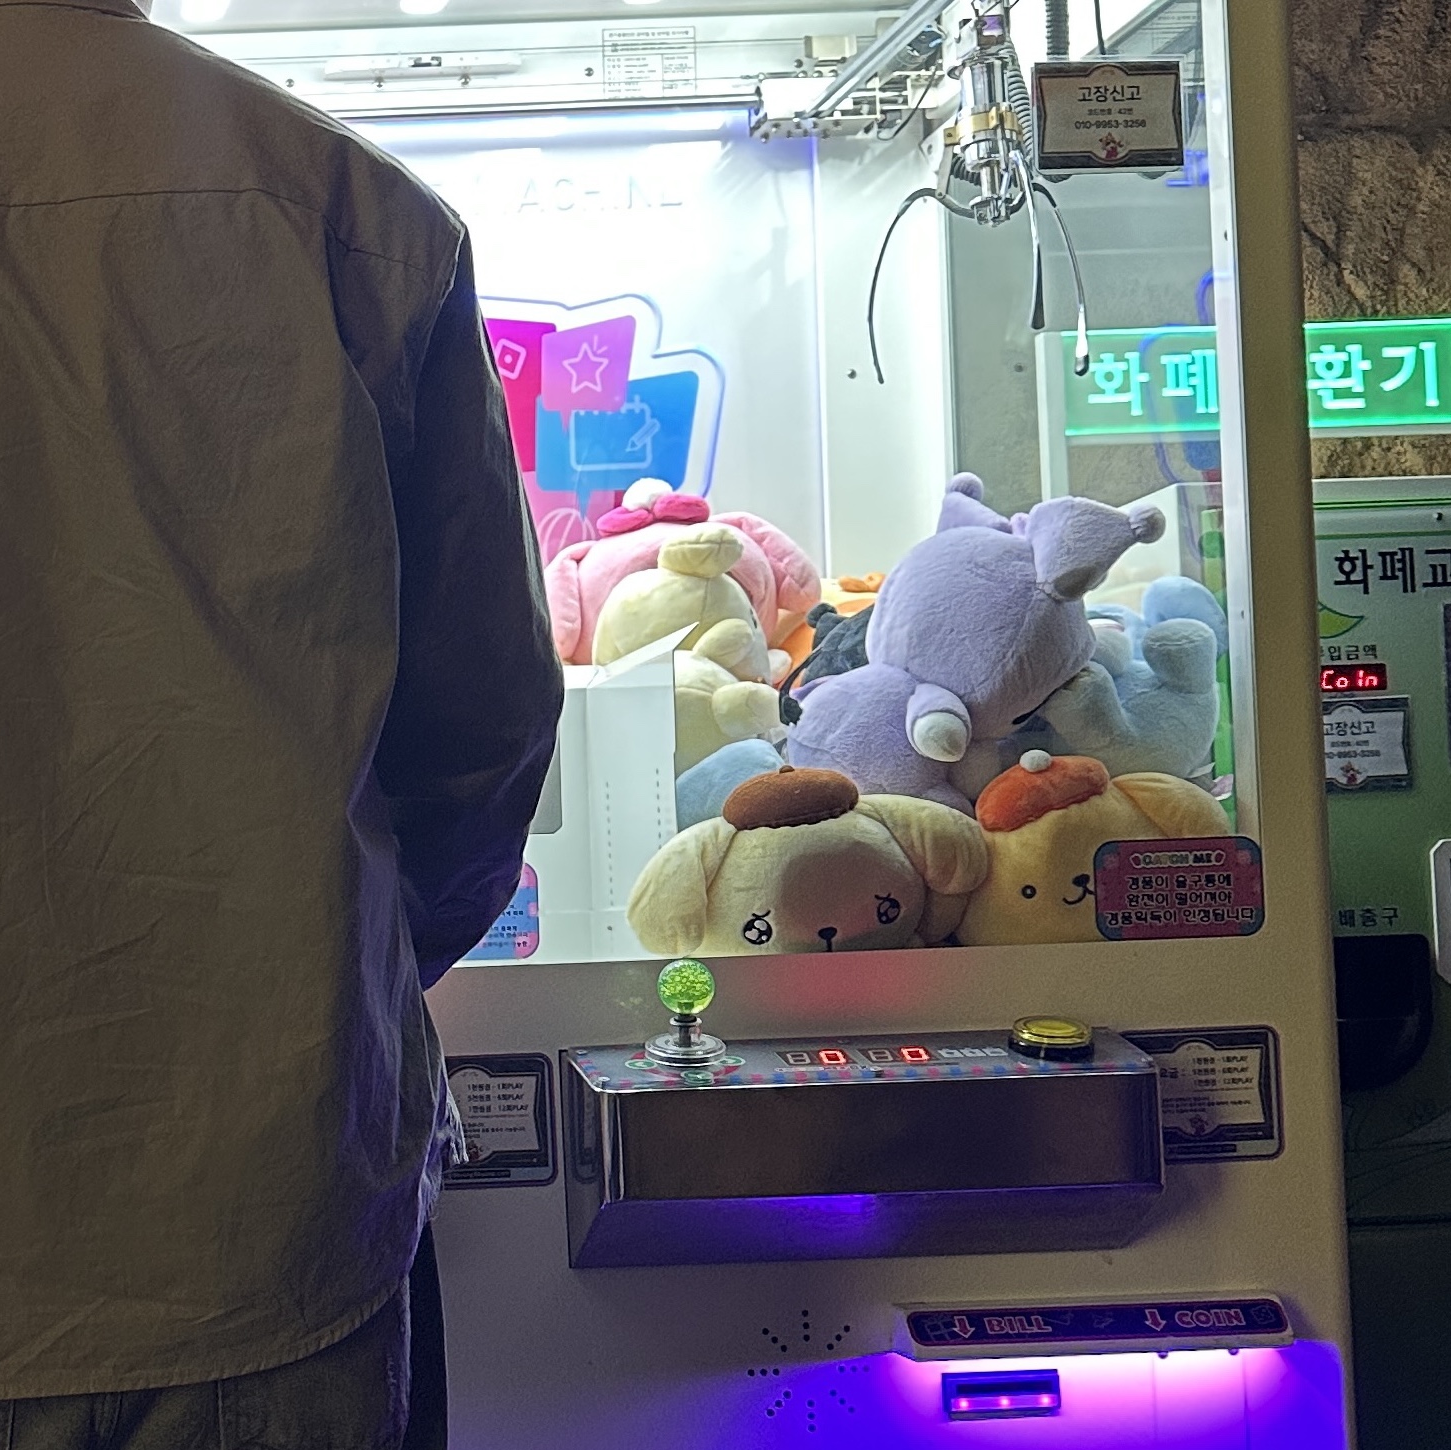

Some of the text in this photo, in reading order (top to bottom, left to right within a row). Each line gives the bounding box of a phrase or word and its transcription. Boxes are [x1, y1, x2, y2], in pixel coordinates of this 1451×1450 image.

[1078, 85, 1142, 102] 고장신고
[1320, 644, 1378, 661] 입금액
[1323, 721, 1376, 736] 고장신고
[1127, 874, 1232, 890] 경품이 출구통에
[1175, 891, 1232, 906] 떨어져야
[1106, 907, 1254, 926] 경품획득이 인정됩니다
[1339, 907, 1398, 928] 배출구
[1160, 1067, 1178, 1078] 요금
[984, 1308, 1246, 1334] BILL COIN
